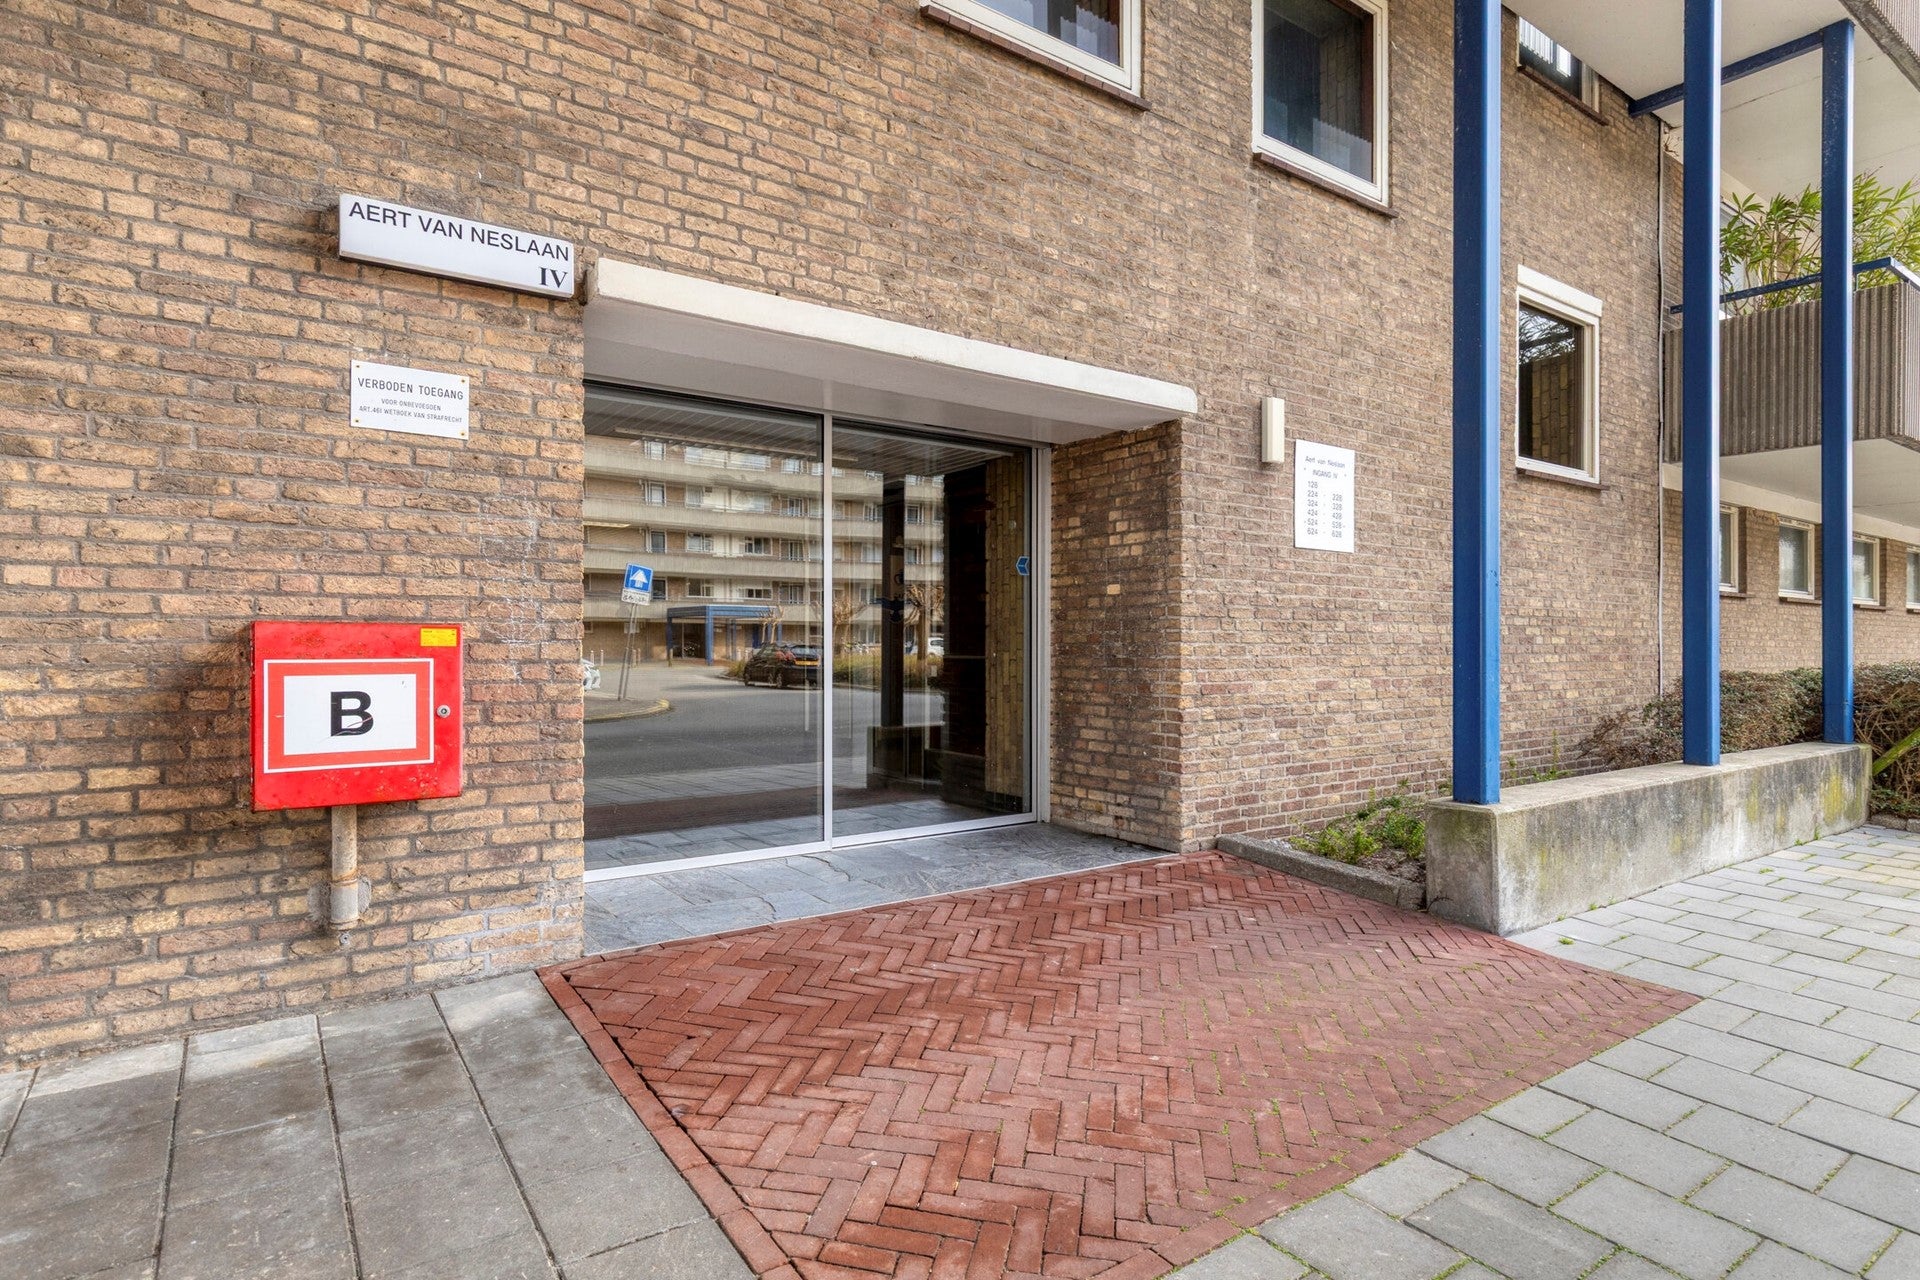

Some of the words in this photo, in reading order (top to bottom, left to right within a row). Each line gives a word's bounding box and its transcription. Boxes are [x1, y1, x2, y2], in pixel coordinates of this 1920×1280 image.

[349, 202, 412, 228] AERT
[418, 215, 463, 240] VAN
[471, 226, 569, 261] NESLAAN
[539, 266, 568, 288] IV
[357, 377, 413, 393] VERBODEN
[418, 385, 464, 400] TOEGANG
[381, 398, 398, 406] VOOR
[399, 400, 441, 411] ONBEVOEGDEN
[384, 408, 412, 417] WETBOEK
[413, 411, 425, 419] VAN
[426, 413, 462, 423] STRAFRECHT
[1312, 469, 1332, 478] INGANG
[330, 690, 374, 737] B
